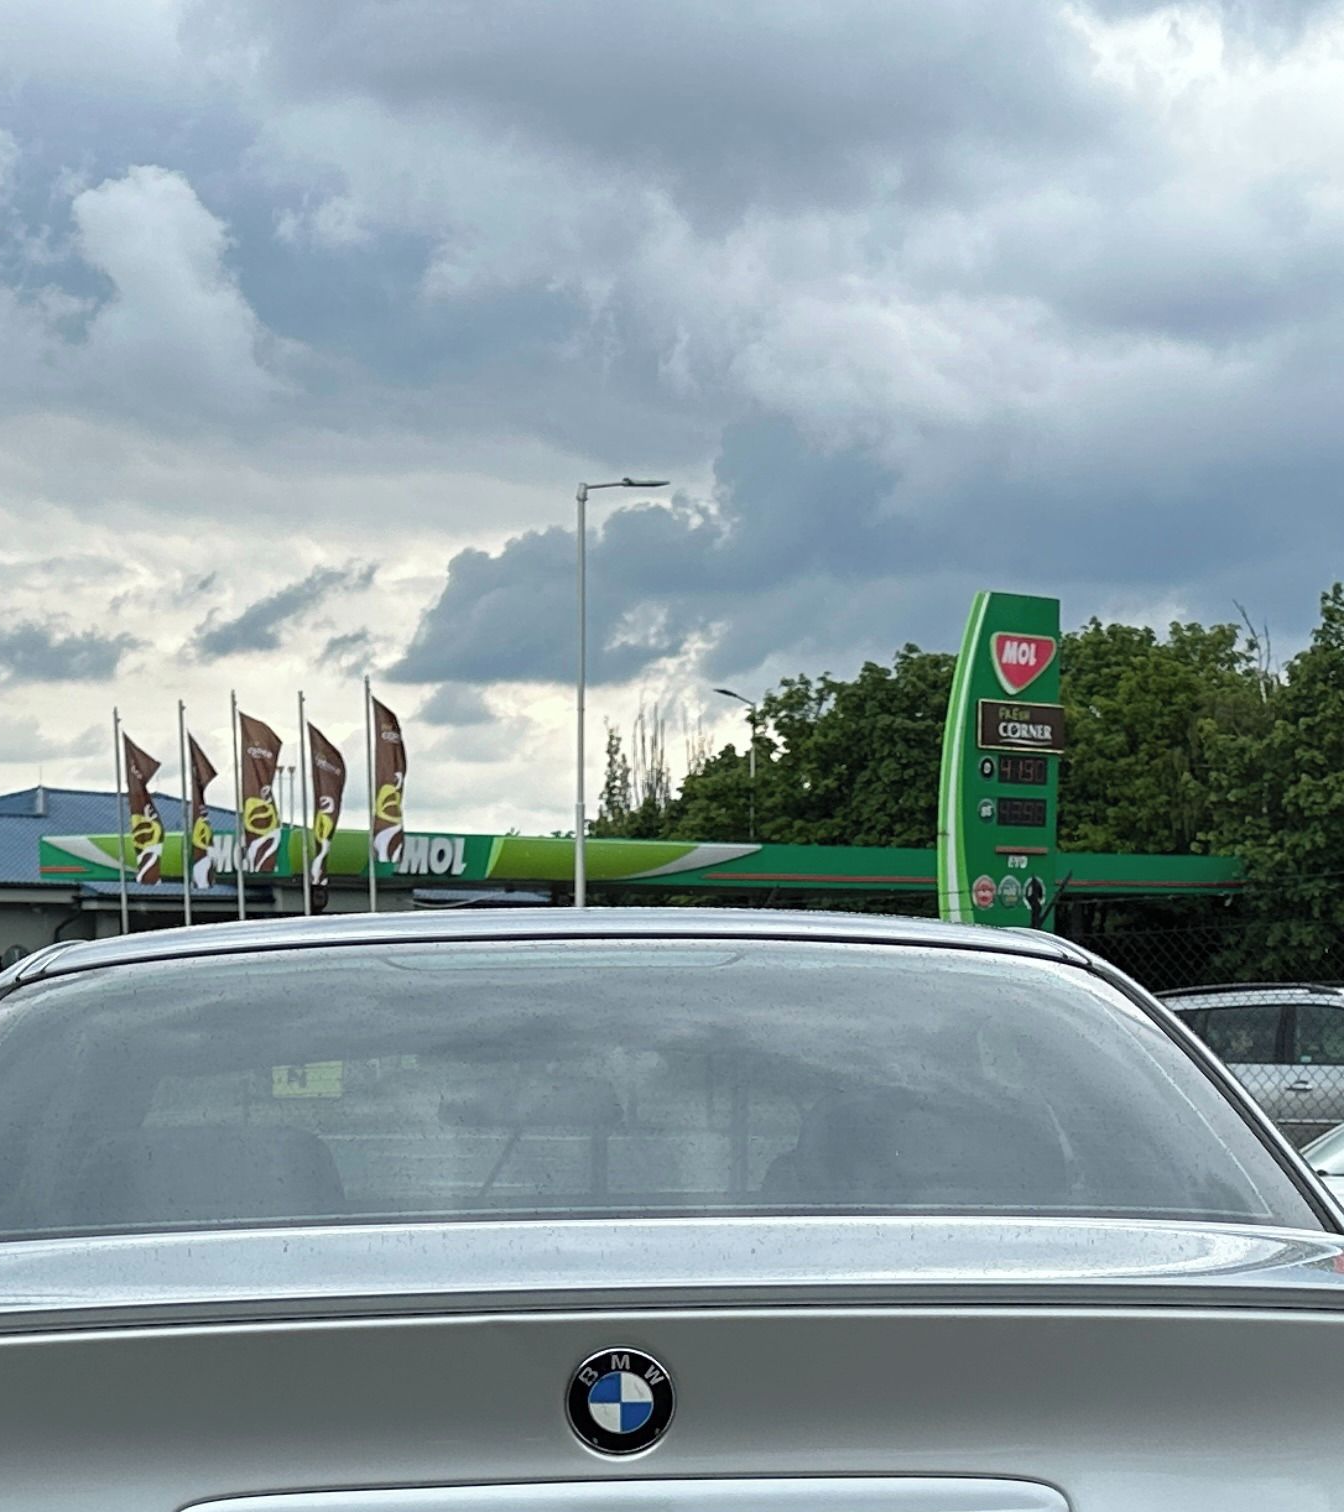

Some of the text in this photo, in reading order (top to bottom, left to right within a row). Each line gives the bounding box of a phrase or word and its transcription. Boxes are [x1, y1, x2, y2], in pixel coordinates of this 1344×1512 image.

[1001, 640, 1037, 666] MOL
[997, 721, 1053, 740] CORNER
[398, 836, 468, 875] MOL
[578, 1354, 665, 1387] BMW
